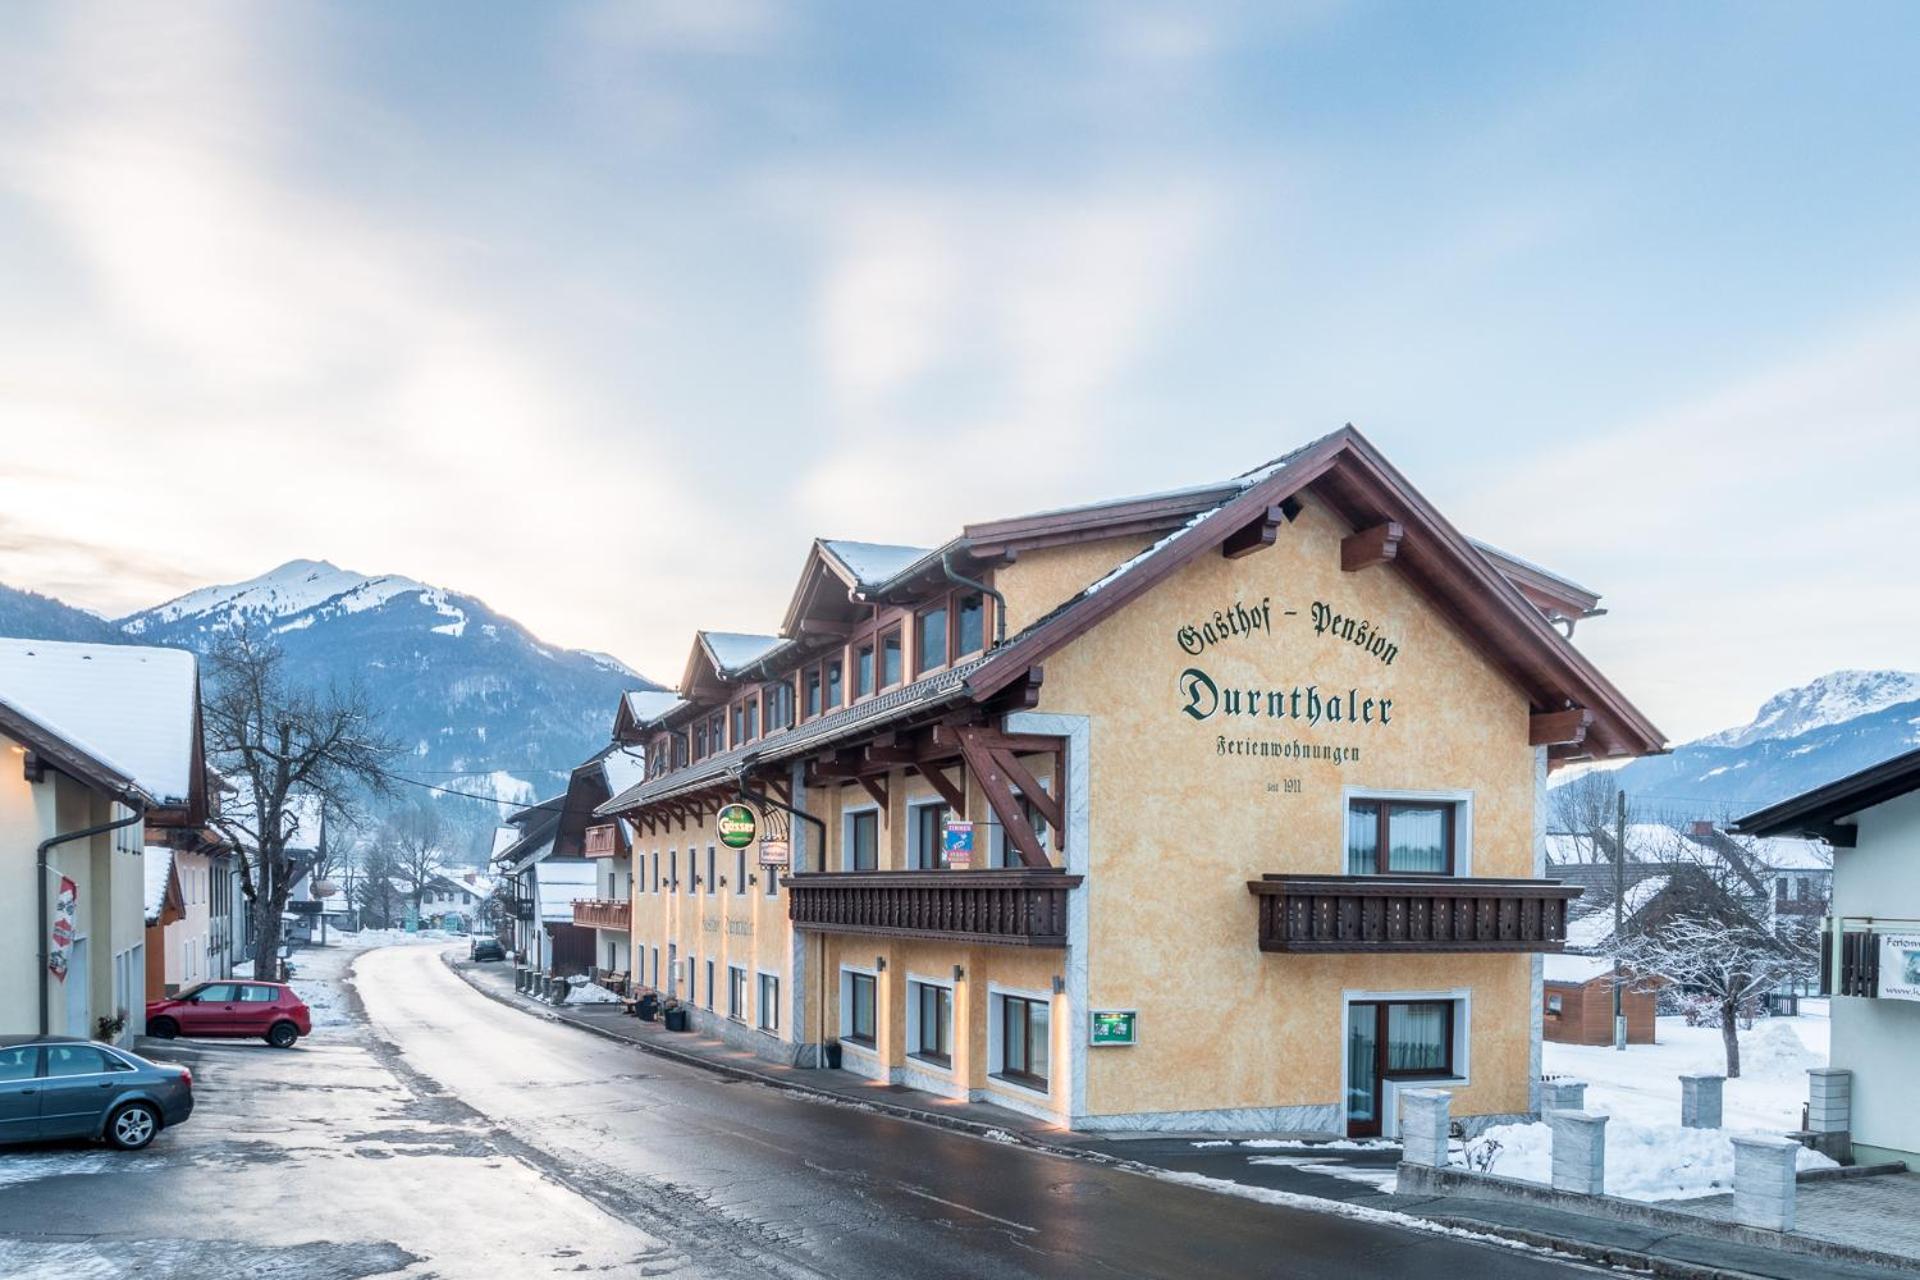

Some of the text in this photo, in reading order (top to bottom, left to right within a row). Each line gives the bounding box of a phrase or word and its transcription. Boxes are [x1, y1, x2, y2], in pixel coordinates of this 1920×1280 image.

[1177, 597, 1271, 656] Gasthof
[1311, 601, 1399, 665] Pension
[1179, 668, 1393, 727] Durnthaler
[1216, 735, 1361, 766] Ferienwohnungen
[1283, 778, 1302, 793] 1911
